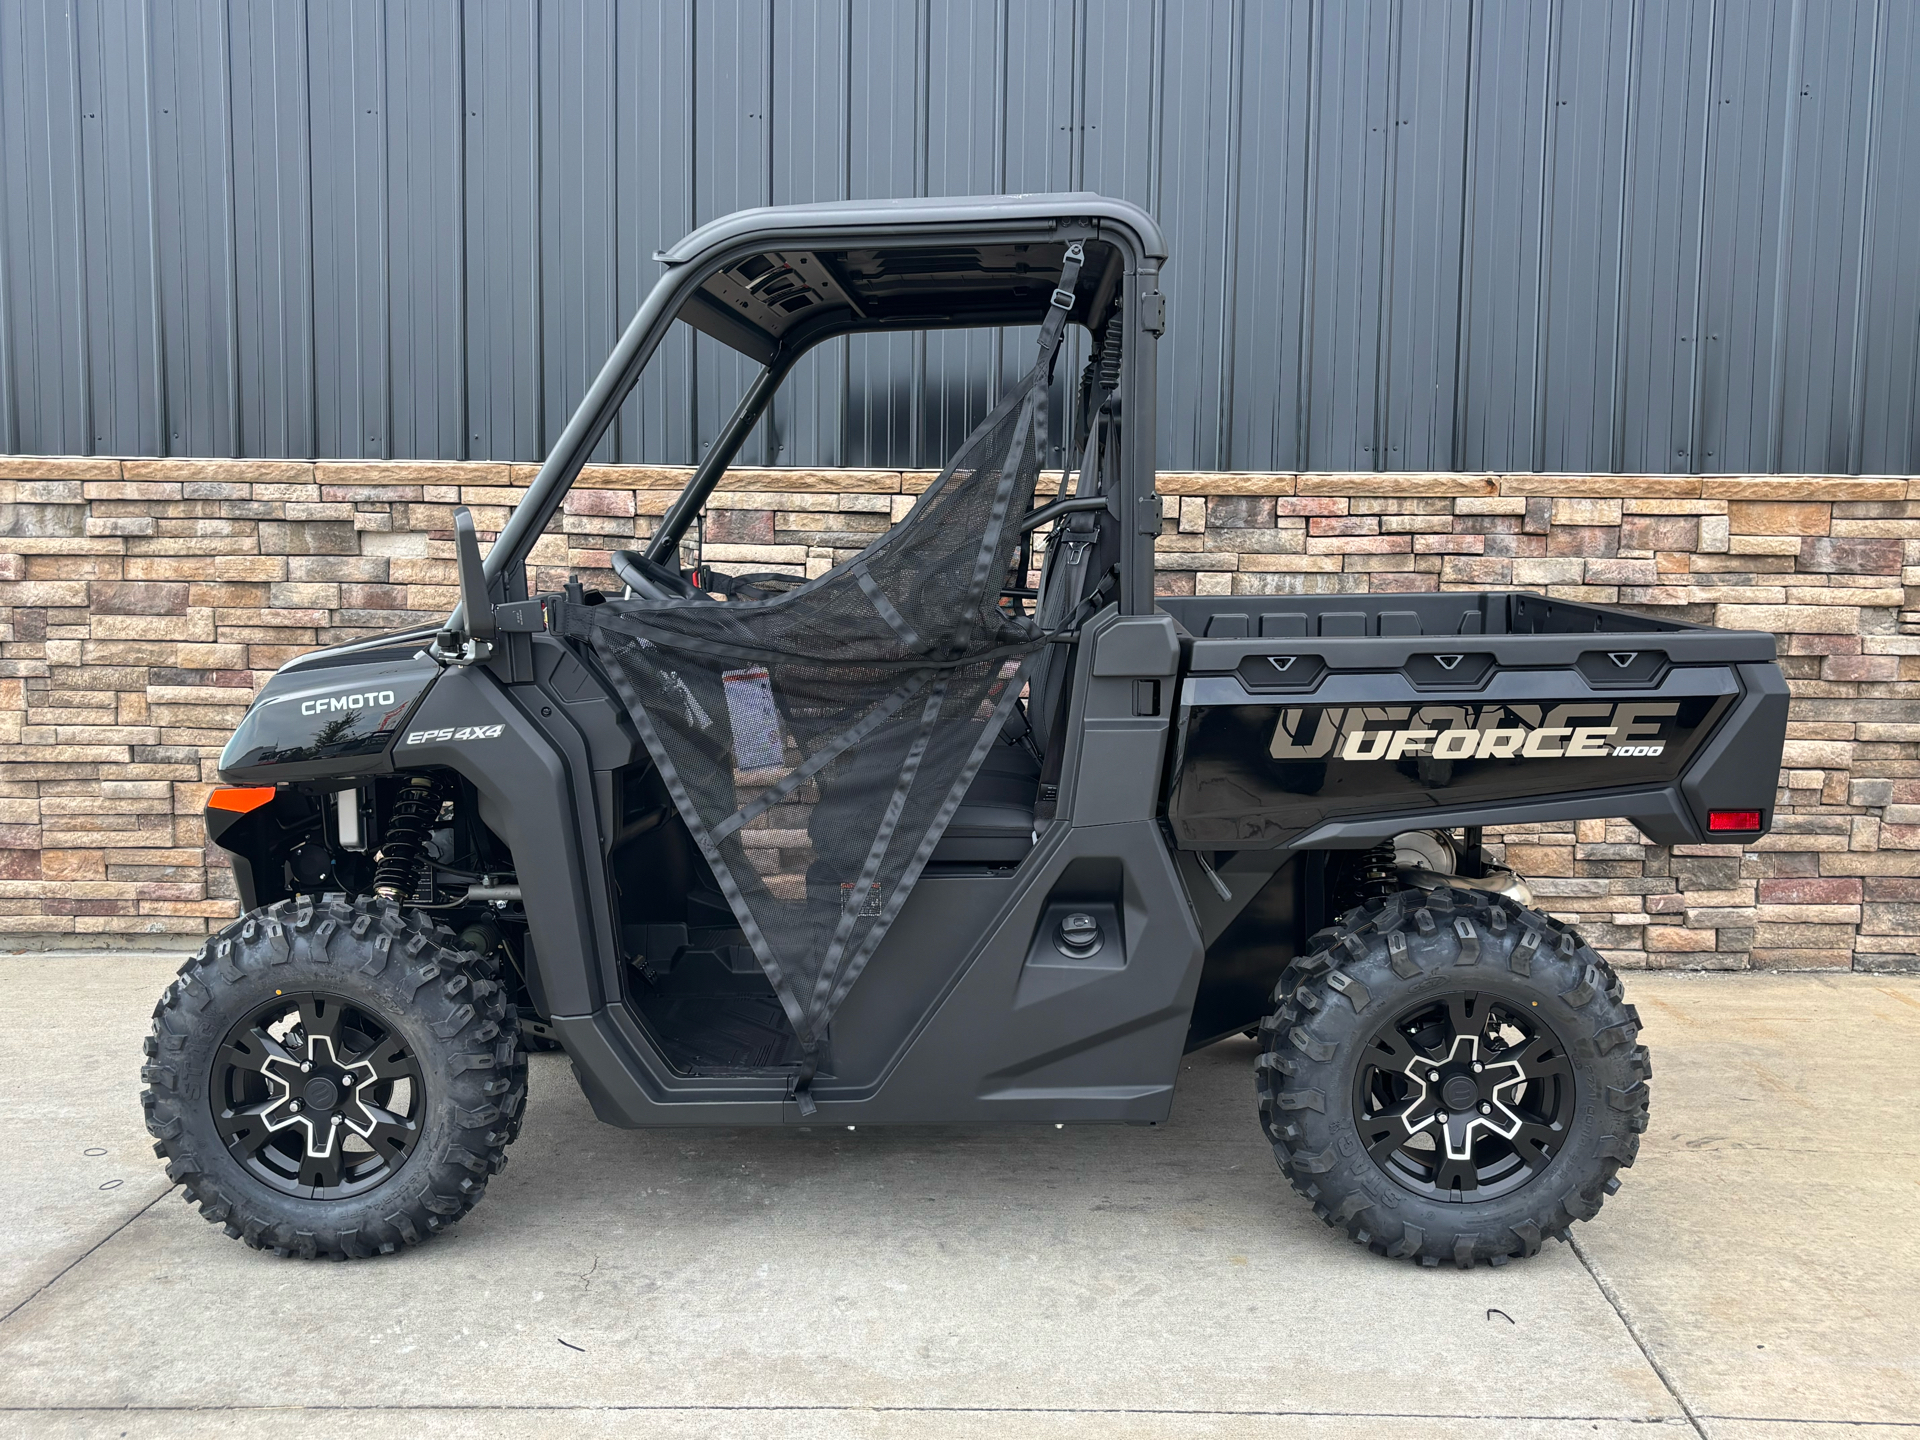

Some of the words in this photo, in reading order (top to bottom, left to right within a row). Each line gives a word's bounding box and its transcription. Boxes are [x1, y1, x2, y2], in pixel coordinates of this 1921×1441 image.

[301, 690, 395, 716] CFMOTO
[1342, 726, 1618, 761] UFORCE
[1611, 746, 1664, 757] 1000
[1337, 1132, 1402, 1210] STAG
